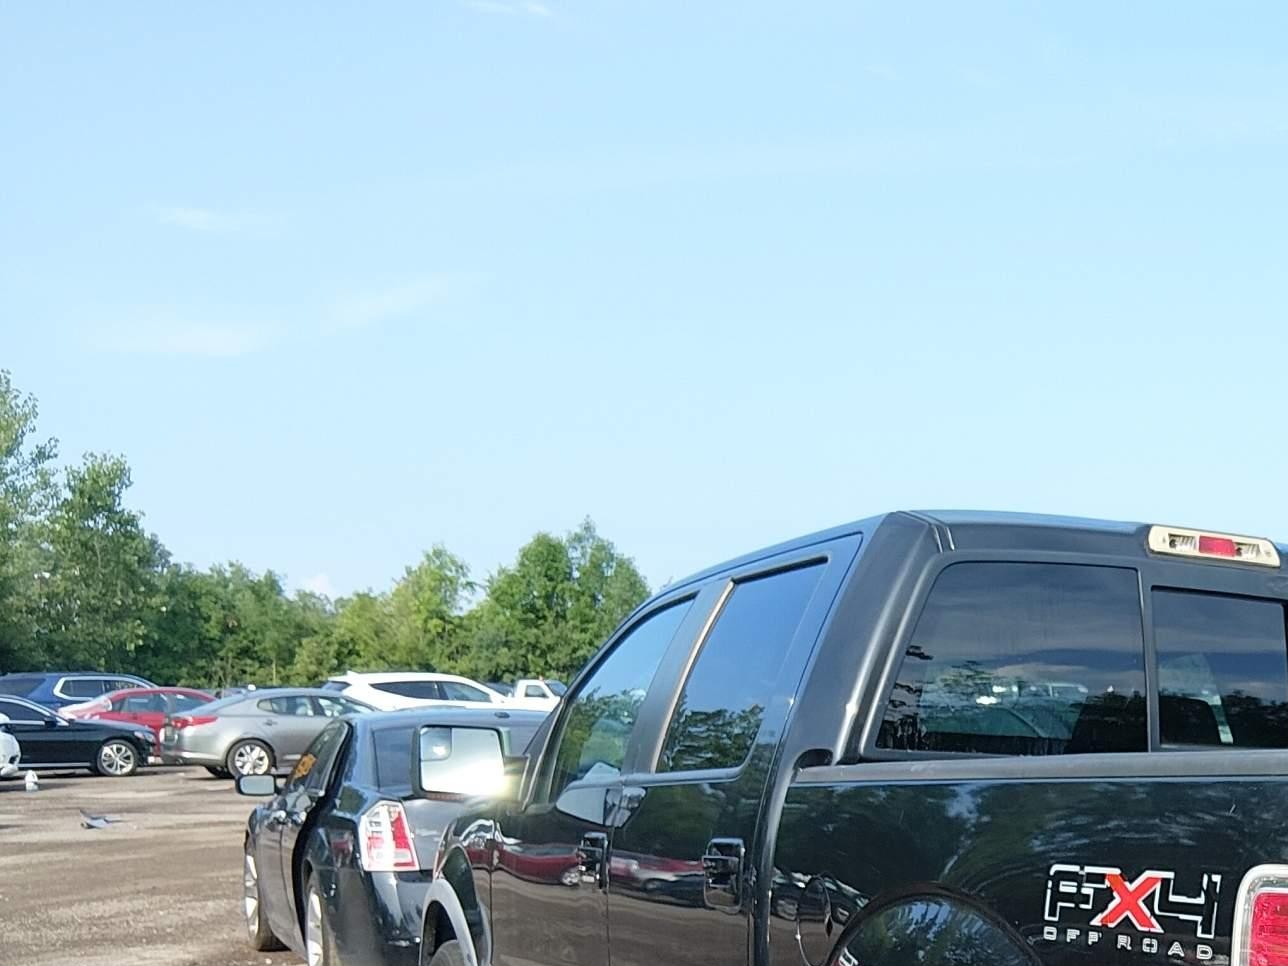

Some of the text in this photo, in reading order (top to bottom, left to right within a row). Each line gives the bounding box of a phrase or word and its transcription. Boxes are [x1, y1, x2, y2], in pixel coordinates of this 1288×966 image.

[1044, 863, 1222, 939] FX4
[1043, 926, 1213, 960] OFF ROAD
